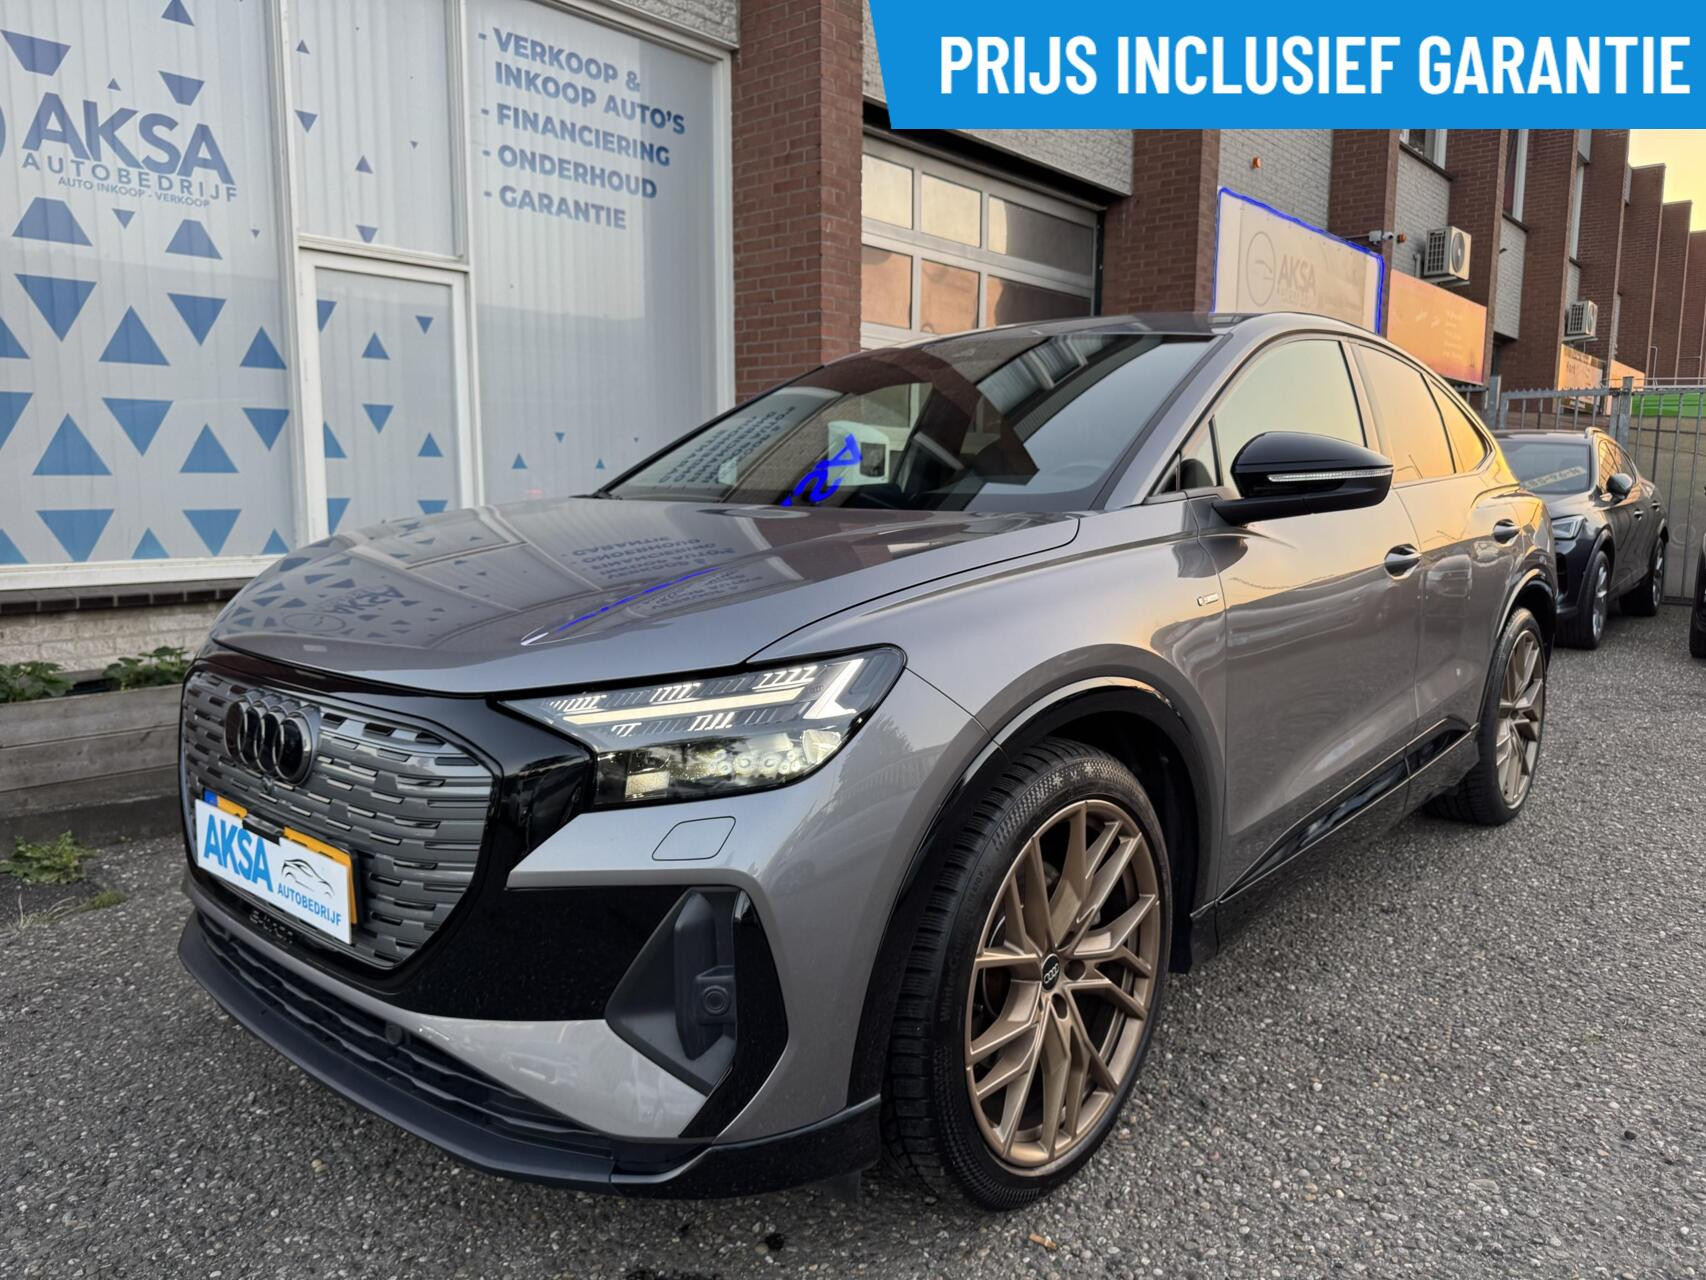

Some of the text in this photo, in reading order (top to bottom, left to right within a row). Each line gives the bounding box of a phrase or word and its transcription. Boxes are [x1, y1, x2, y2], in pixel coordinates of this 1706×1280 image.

[493, 27, 640, 92] VERKOOP &
[495, 61, 686, 135] INKOOP AUTO'S
[21, 91, 236, 186] AKSA
[496, 102, 671, 167] FINANCIERING
[21, 151, 238, 203] AUTOBEDRIJF
[58, 176, 94, 191] AUTO
[96, 182, 146, 199] INKOOP
[155, 191, 211, 208] VERKOOP
[498, 144, 658, 199] ONDERHOUD
[499, 184, 627, 230] GARANTIE
[1277, 253, 1317, 297] AKSA
[203, 813, 275, 893] AKSA
[277, 882, 342, 926] AUTOBEDRIJF
